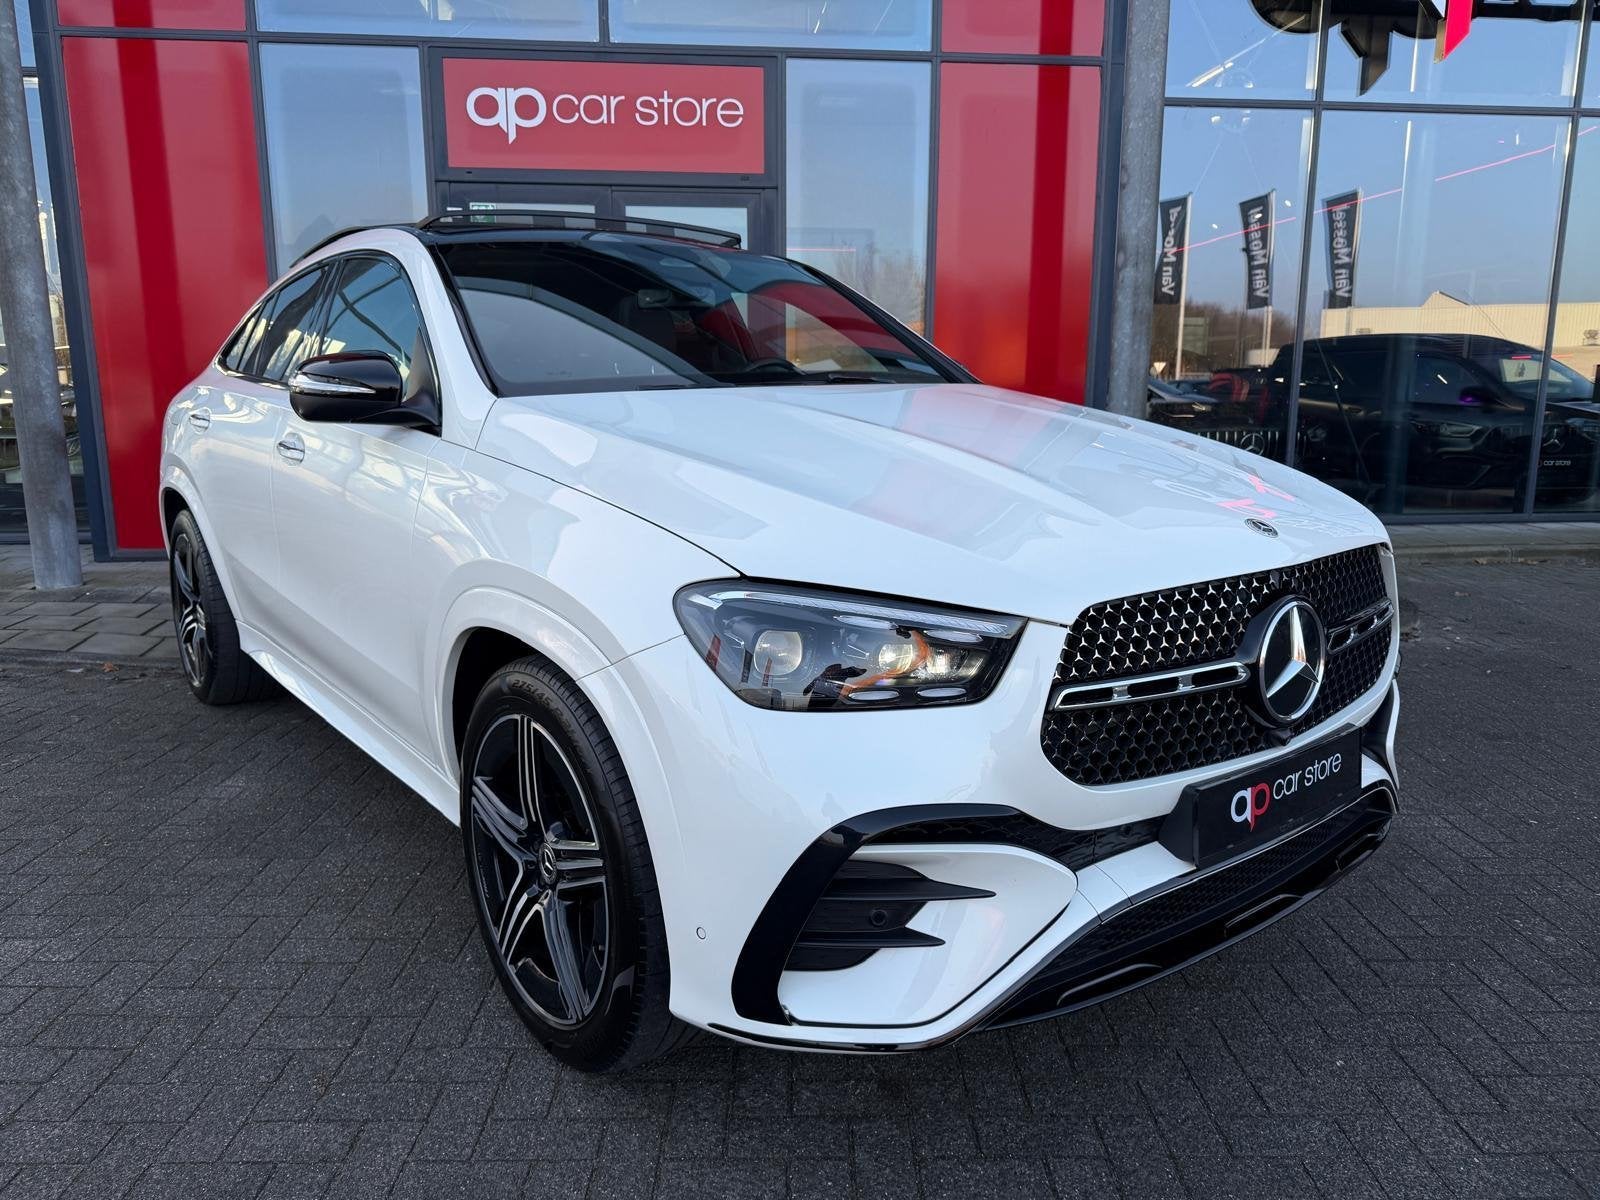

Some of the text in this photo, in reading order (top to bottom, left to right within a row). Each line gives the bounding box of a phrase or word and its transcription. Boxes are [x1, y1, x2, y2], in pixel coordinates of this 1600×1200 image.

[552, 93, 625, 125] car
[634, 90, 744, 128] store
[1273, 770, 1302, 800] car
[1304, 752, 1342, 787] store
